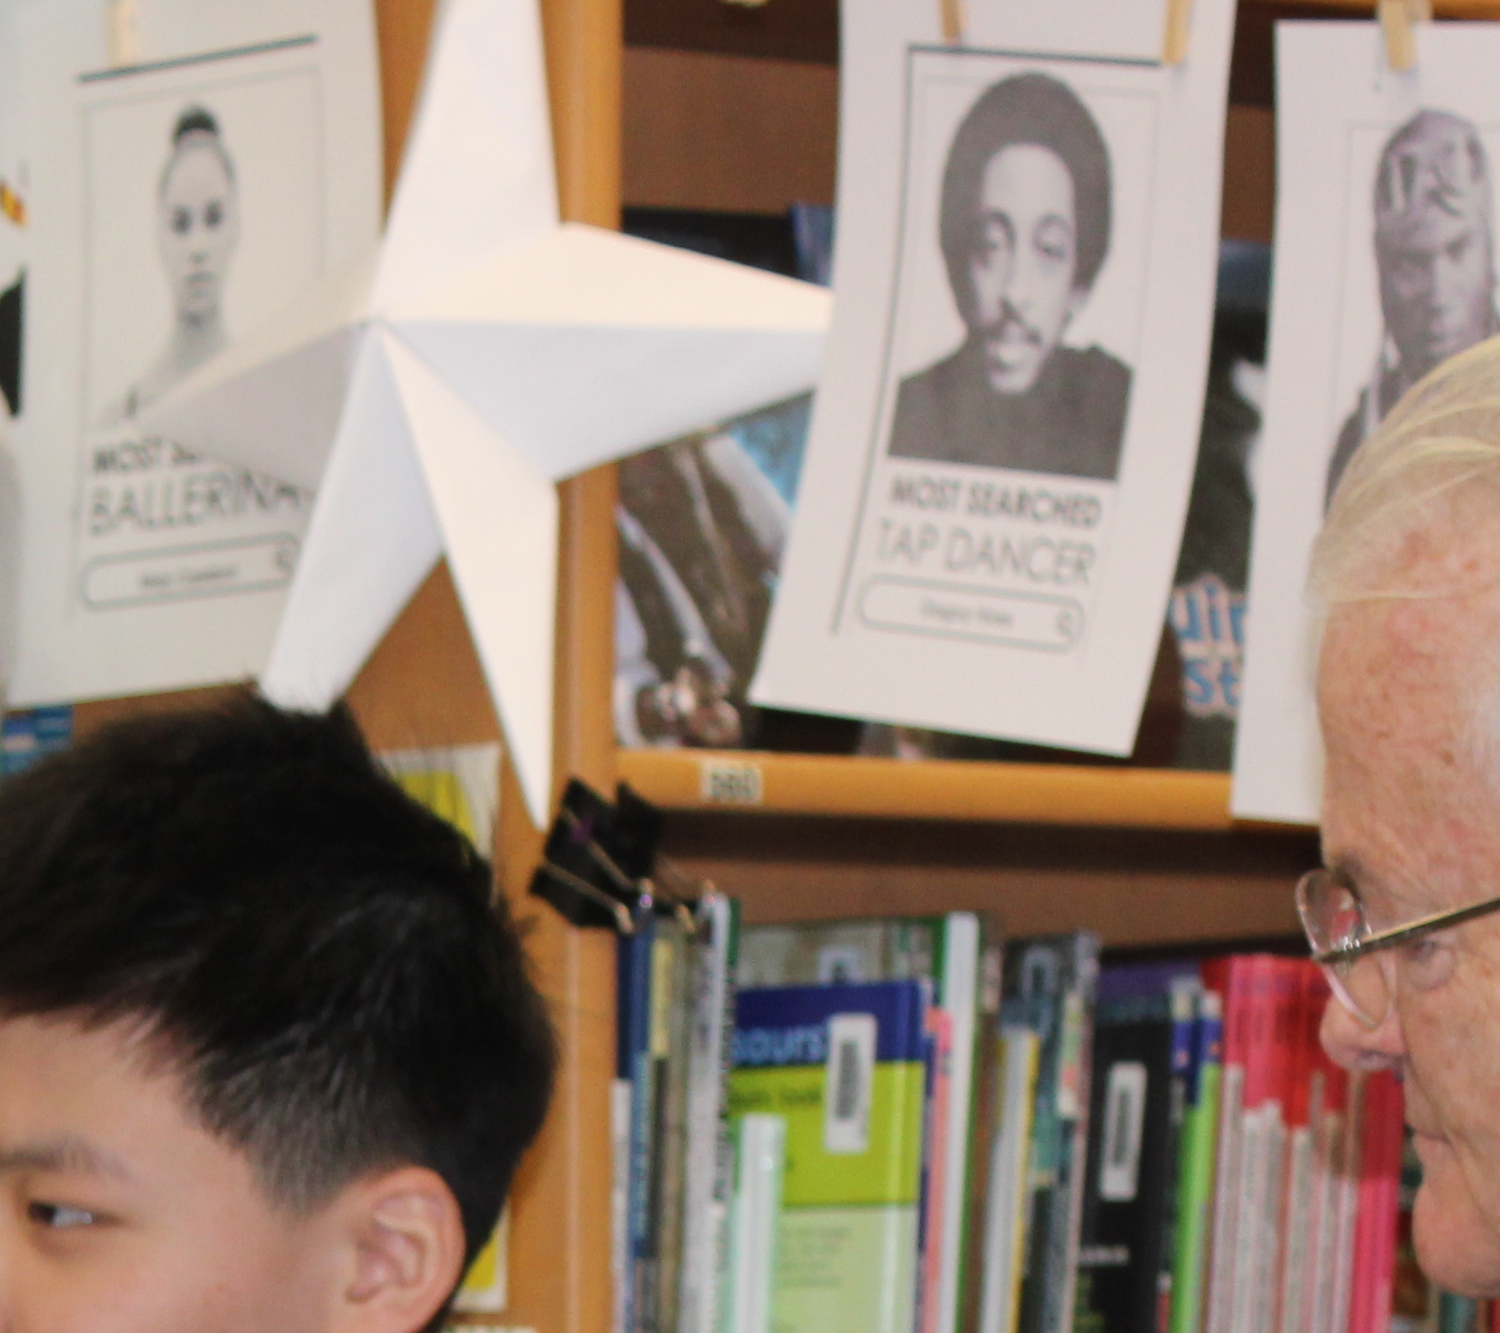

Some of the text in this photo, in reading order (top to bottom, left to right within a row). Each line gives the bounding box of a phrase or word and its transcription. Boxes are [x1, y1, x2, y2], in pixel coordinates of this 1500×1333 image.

[890, 475, 1102, 528] MOST SEARCHED
[877, 516, 1098, 585] TAP DANCER
